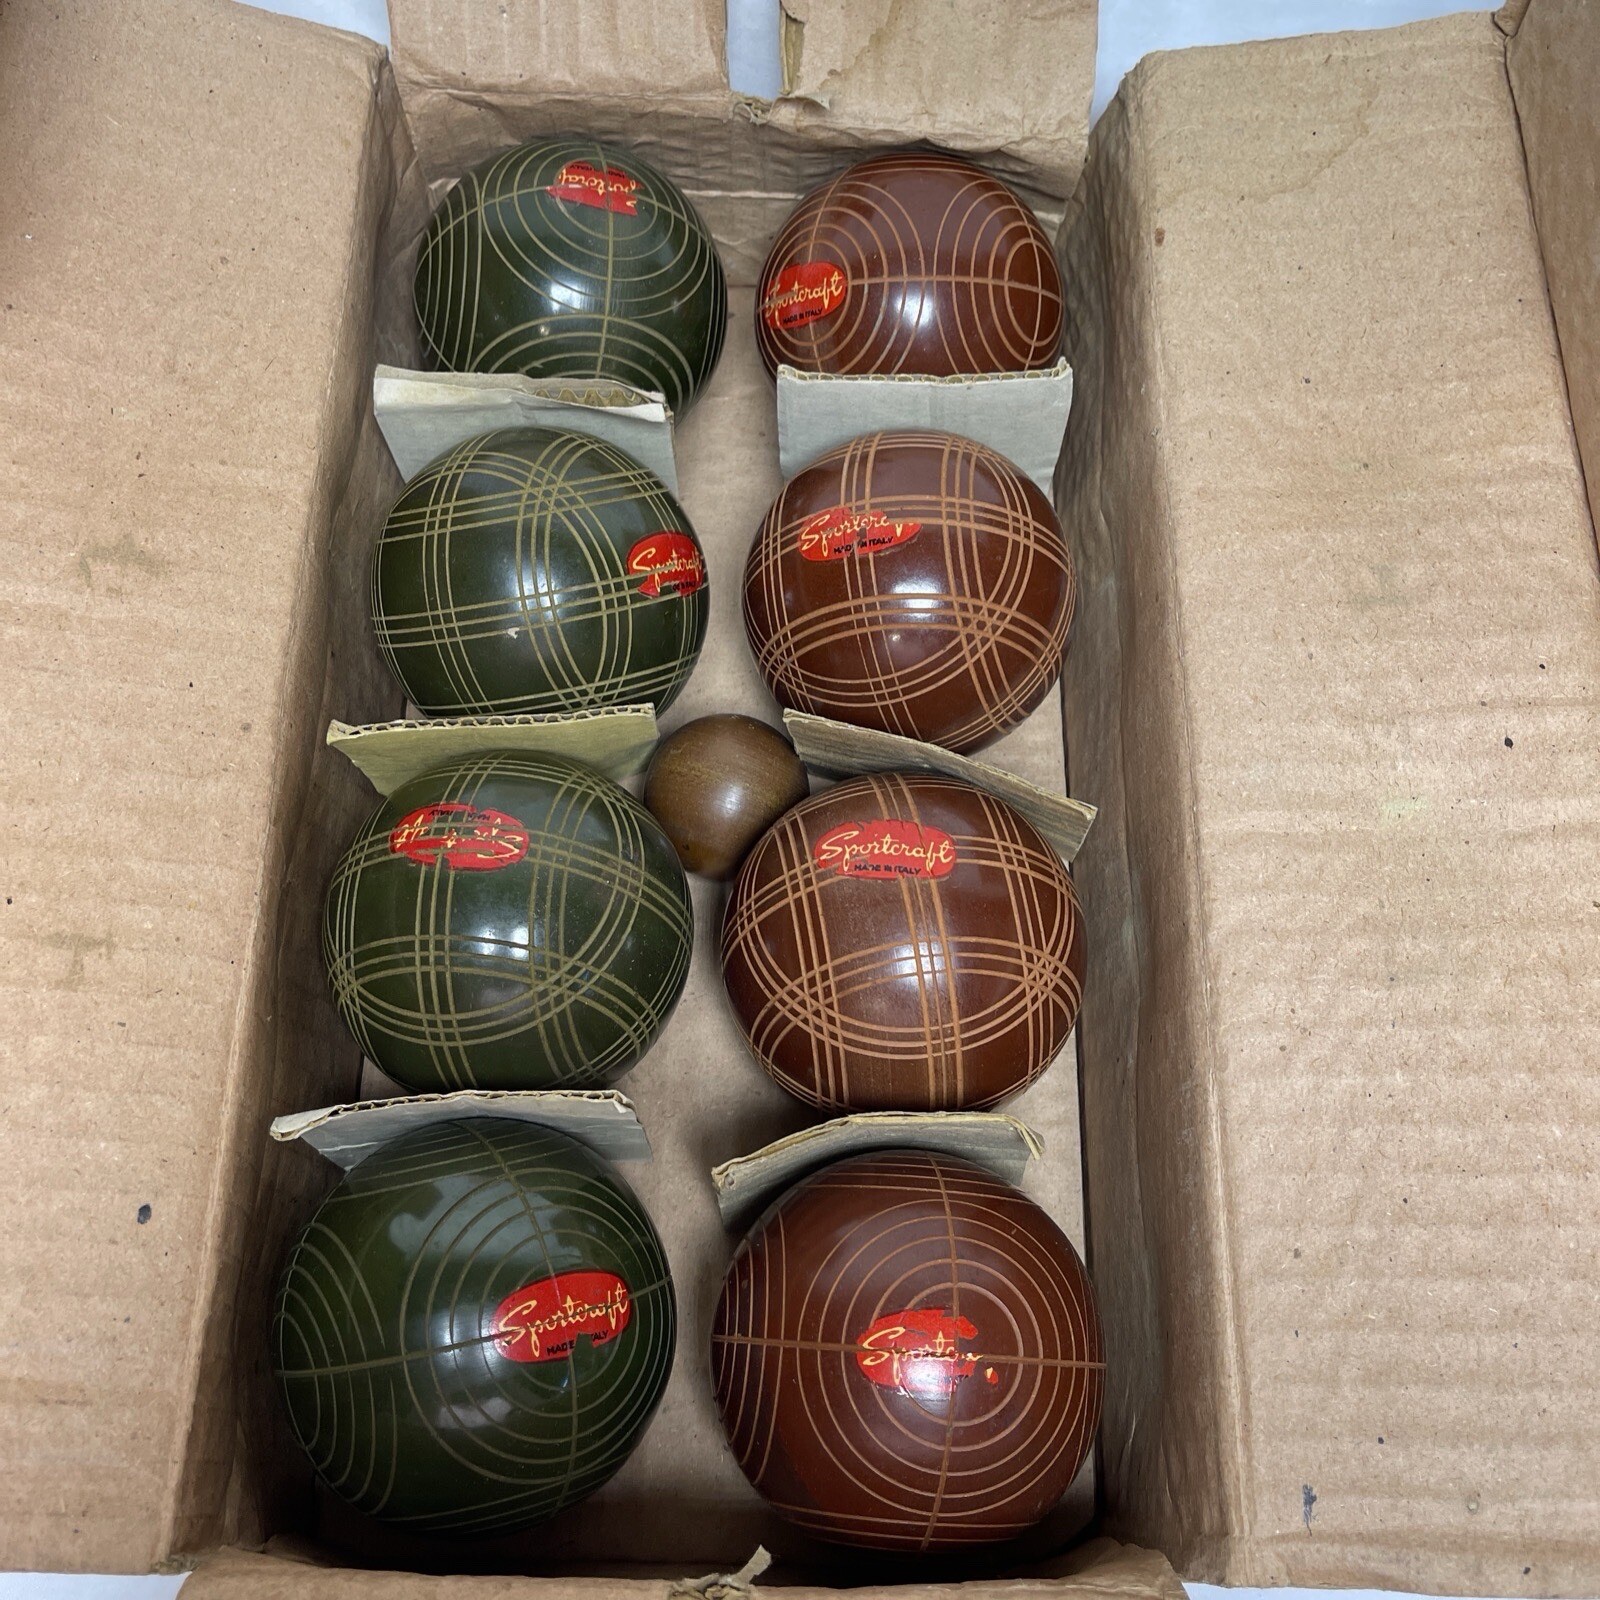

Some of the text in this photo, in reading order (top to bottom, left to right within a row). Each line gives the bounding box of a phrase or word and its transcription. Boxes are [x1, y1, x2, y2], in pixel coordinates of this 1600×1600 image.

[805, 307, 823, 318] ITALY
[833, 545, 854, 555] MAD
[868, 536, 894, 547] ITALY
[820, 830, 955, 872] Sportcraft
[854, 863, 922, 875] MADE IN ITALY
[499, 1282, 628, 1358] Sportcraft
[546, 1340, 575, 1356] MADE
